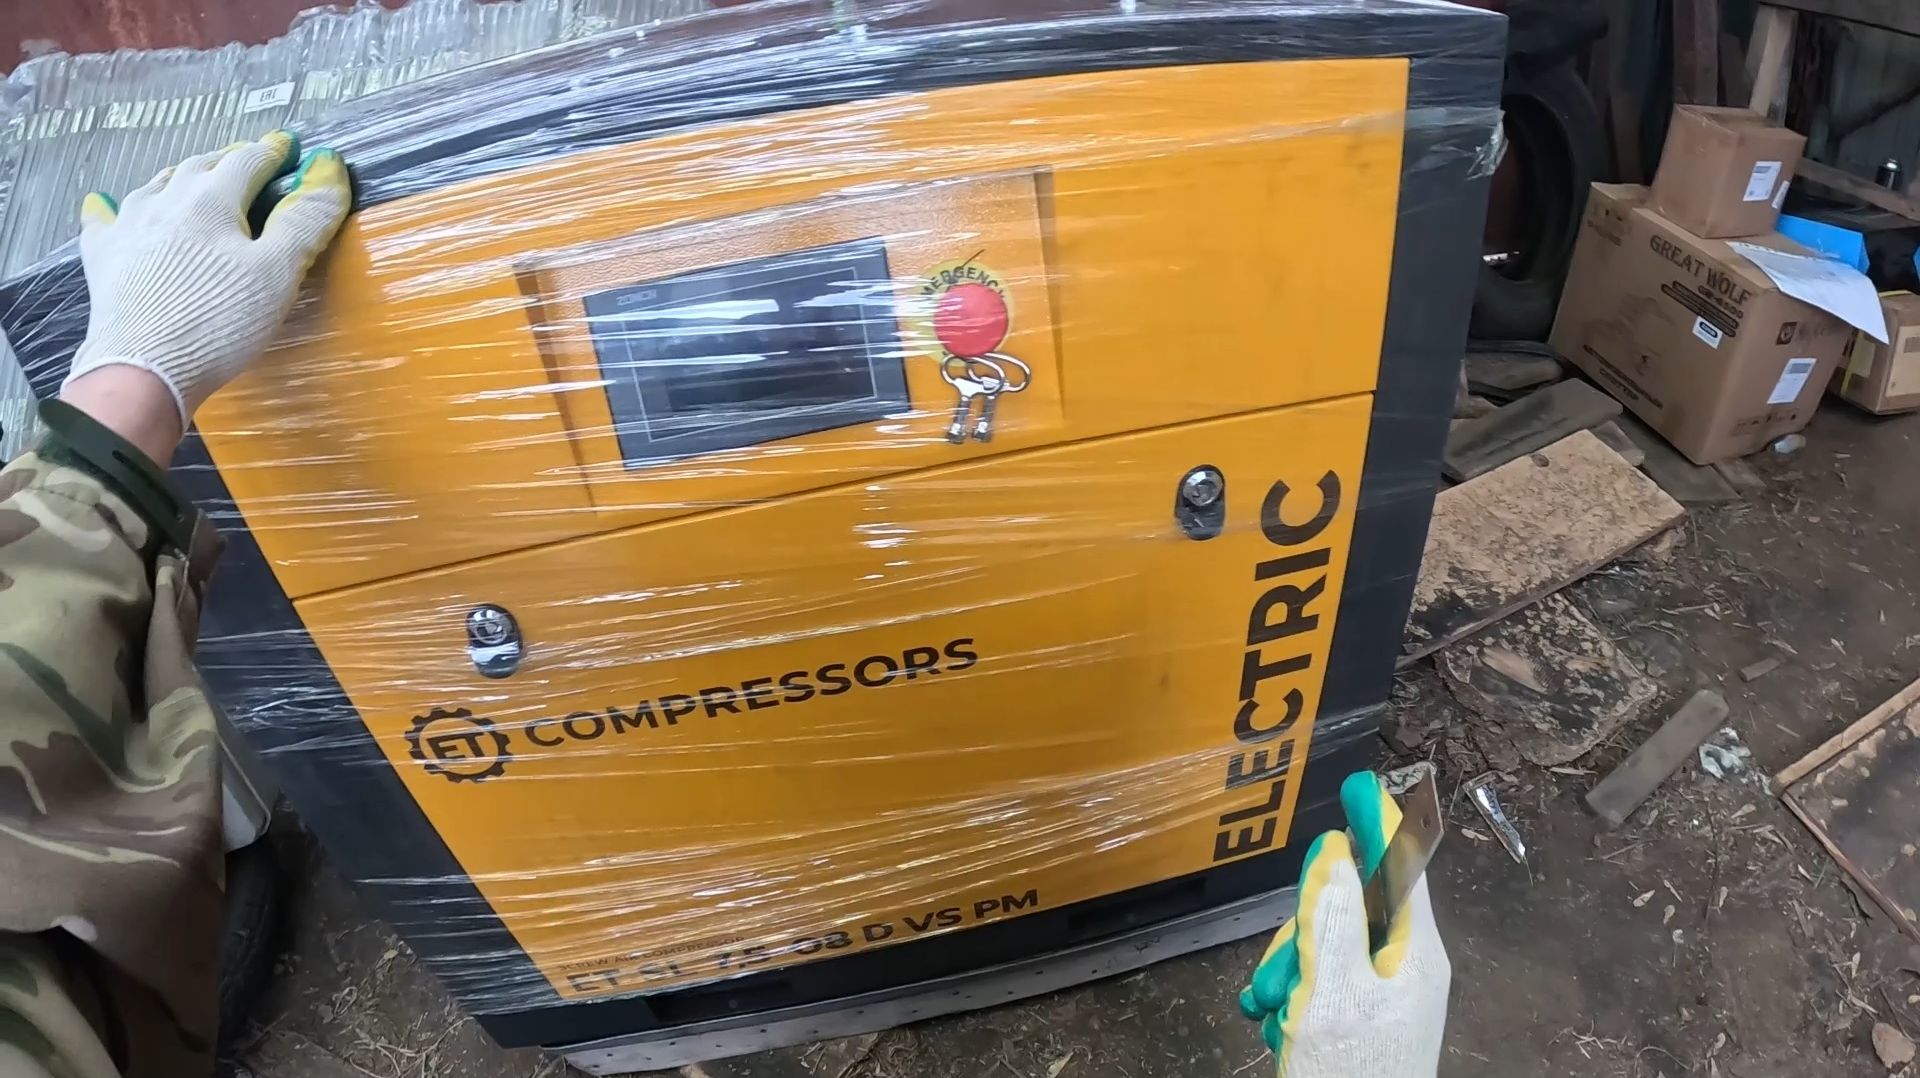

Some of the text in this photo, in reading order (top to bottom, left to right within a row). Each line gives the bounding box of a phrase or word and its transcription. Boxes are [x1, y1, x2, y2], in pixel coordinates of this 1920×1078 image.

[1650, 235, 1704, 277] GREAT
[1707, 268, 1751, 305] WOLF
[525, 638, 978, 747] COMPRESSORS
[1213, 470, 1341, 863] ELECTRIC
[426, 732, 489, 760] ET
[863, 923, 894, 942] D
[903, 907, 962, 932] VS
[974, 889, 1038, 919] PM
